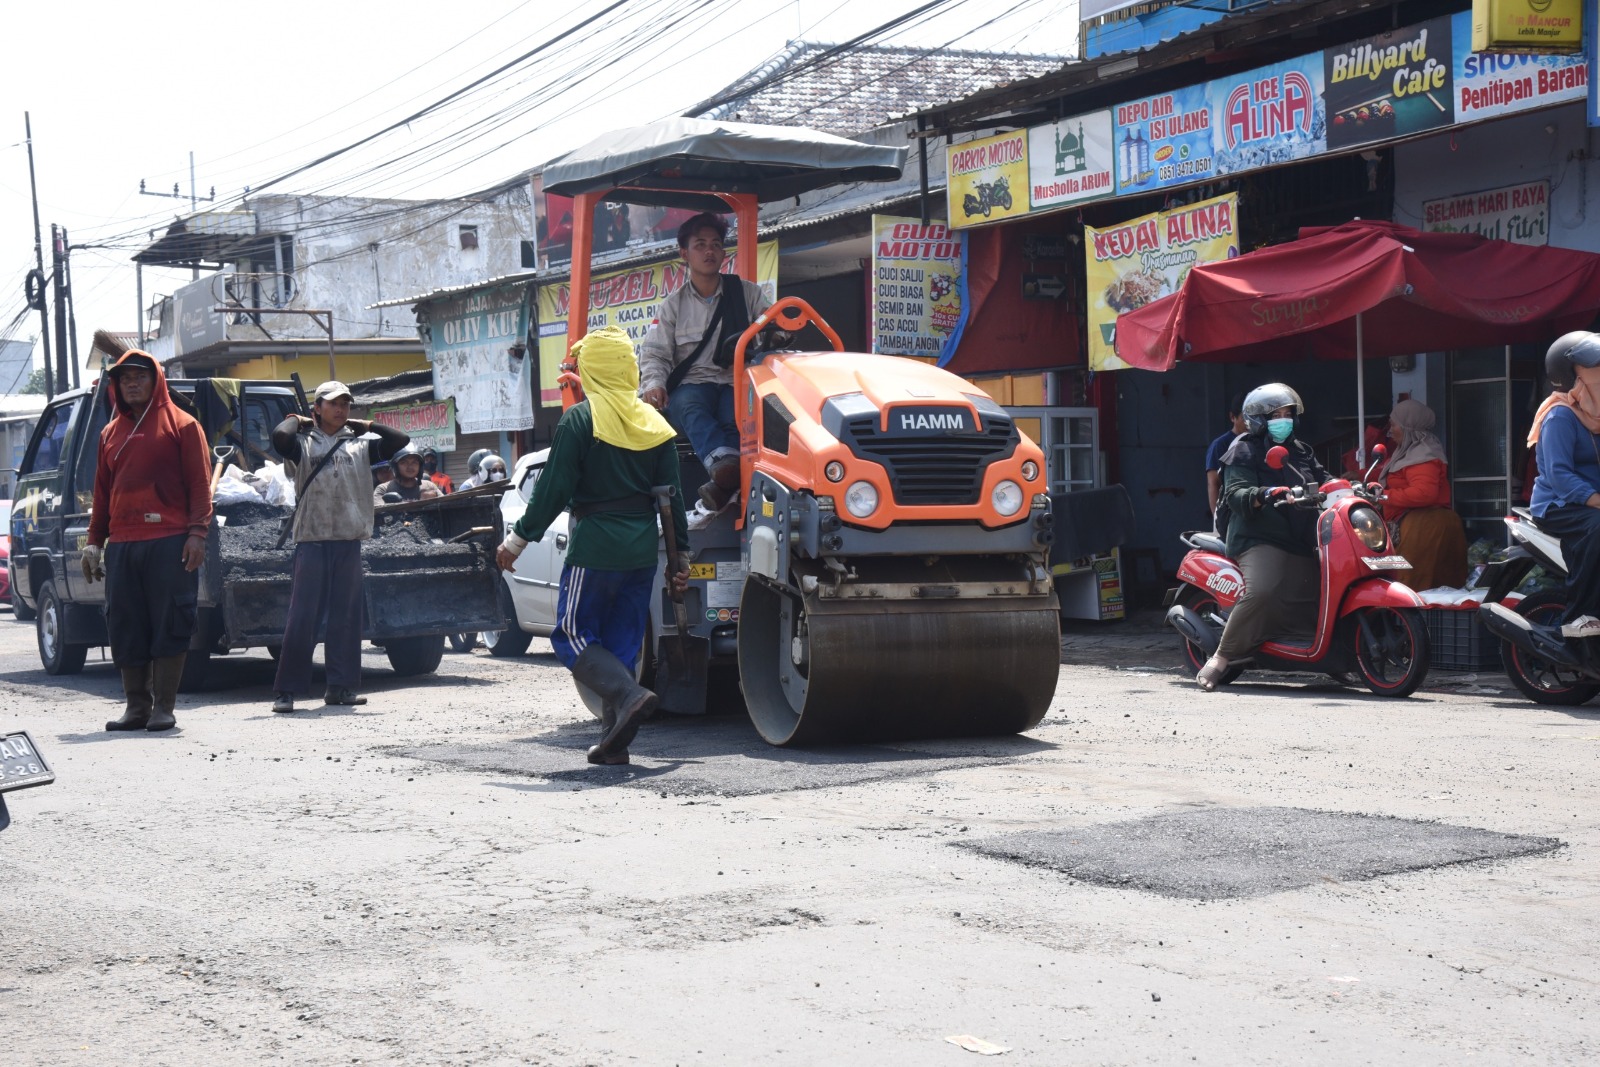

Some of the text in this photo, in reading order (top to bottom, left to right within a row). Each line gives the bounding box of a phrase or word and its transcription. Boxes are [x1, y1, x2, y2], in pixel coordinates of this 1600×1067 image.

[1518, 27, 1561, 38] Lebih Manjur
[1527, 14, 1571, 27] MANCUR
[1331, 28, 1428, 83] Billyard
[1254, 77, 1279, 102] ICE
[1392, 58, 1446, 97] Cafe
[1461, 77, 1533, 112] Penitipan
[1118, 95, 1174, 125] DEPO AIR
[1224, 70, 1313, 151] ALINA
[1150, 108, 1209, 140] ISI ULANG
[952, 137, 1024, 175] PARKIR MOTOR
[1159, 164, 1176, 181] 0851
[1177, 161, 1194, 177] 3472
[1195, 158, 1212, 173] 0501
[1034, 180, 1080, 201] Musholla
[1081, 171, 1111, 191] ARUM
[1478, 191, 1508, 215] HARI
[1512, 185, 1545, 209] RAYA
[1093, 200, 1233, 261] KEDAI ALINA
[1141, 249, 1197, 274] Prasmanan
[879, 266, 924, 283] CUCI SALJU
[555, 269, 658, 317] MUBEL
[878, 283, 924, 300] CUCI BIASA
[618, 307, 645, 323] KACA
[878, 300, 923, 317] SEMIR BAN
[934, 304, 960, 315] PROM
[443, 316, 481, 346] OLIV
[878, 317, 895, 332] CAS
[896, 318, 919, 333] ACCU
[878, 334, 940, 351] TAMBAH ANGIN
[402, 402, 450, 432] CAMPUR
[901, 414, 964, 430] HAMM
[1206, 573, 1245, 597] SCOOPY
